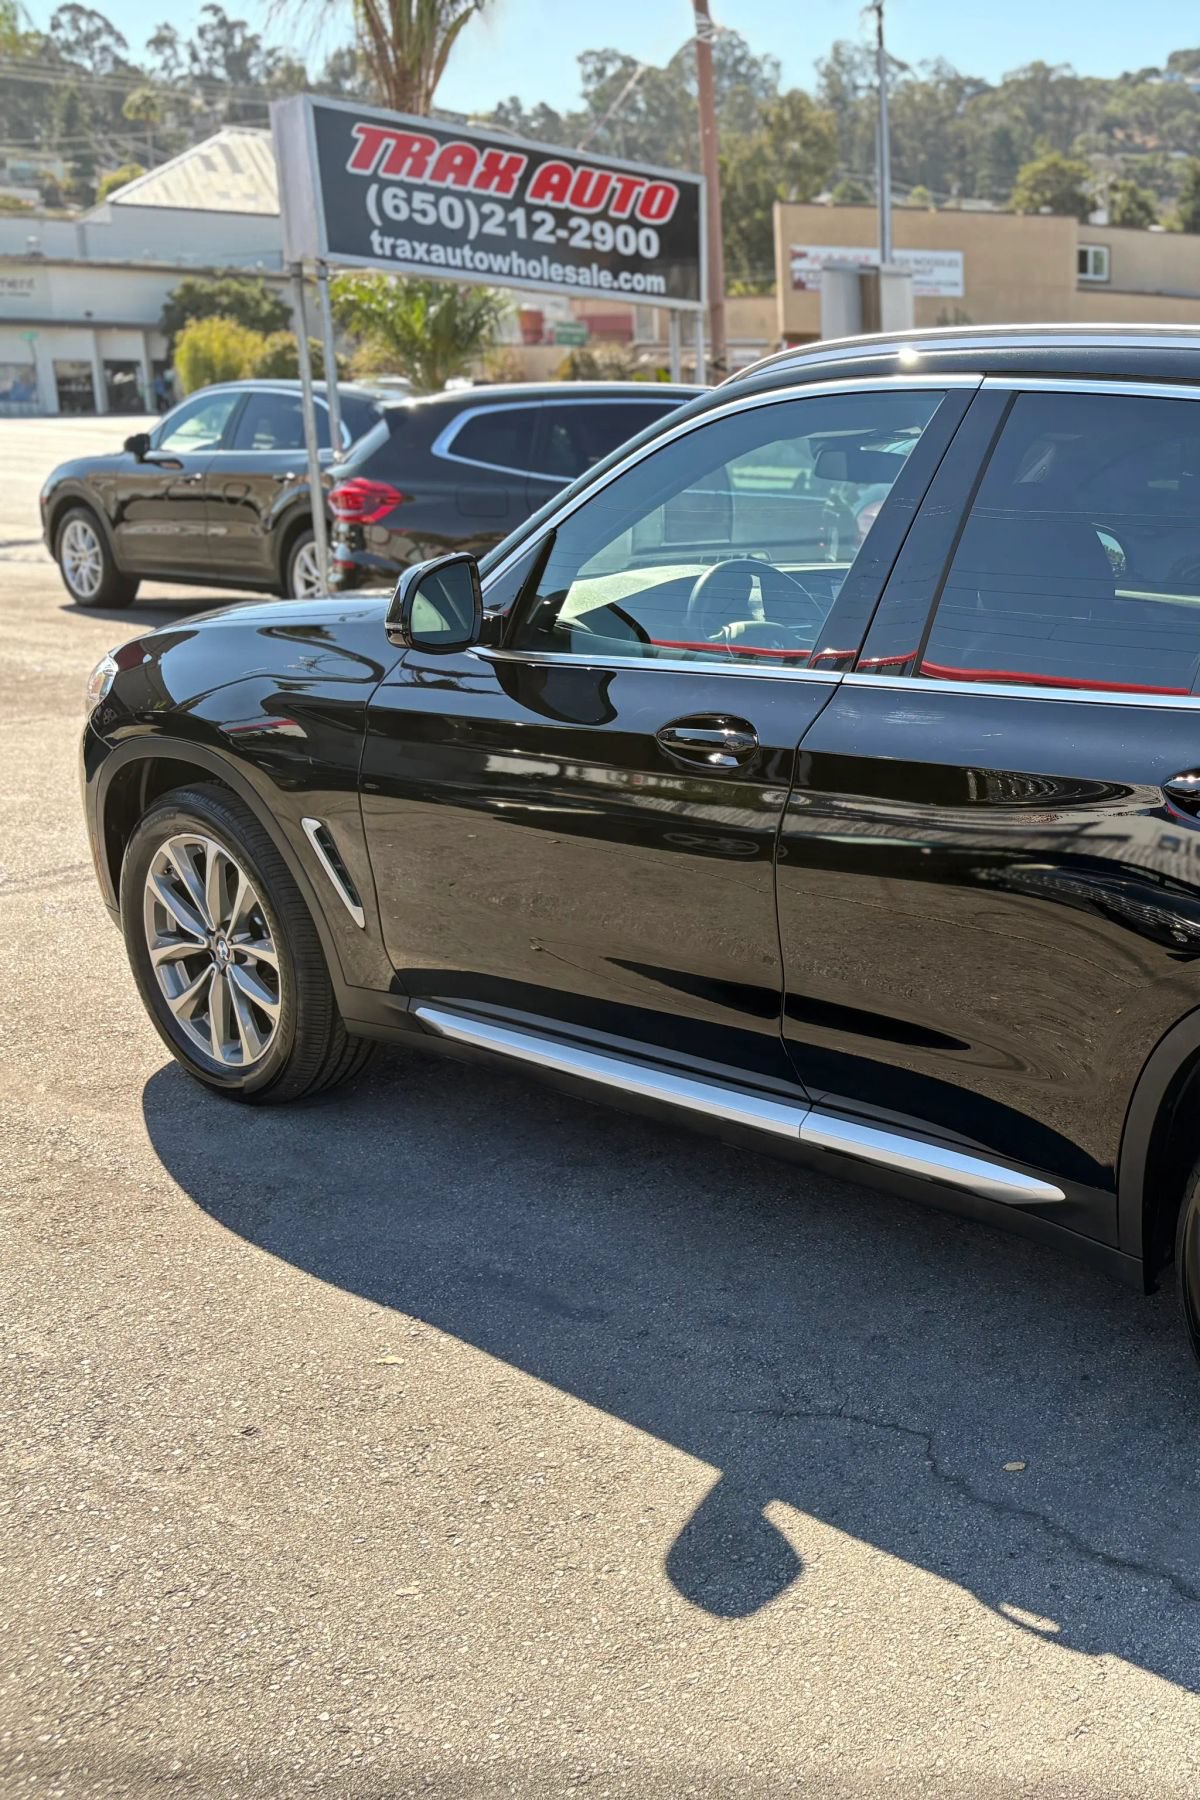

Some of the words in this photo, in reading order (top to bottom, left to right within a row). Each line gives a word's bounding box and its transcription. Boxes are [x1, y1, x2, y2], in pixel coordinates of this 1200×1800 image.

[346, 122, 527, 199] TRAX
[525, 160, 680, 225] AUTO
[366, 183, 660, 259] (650)212-2900
[370, 229, 667, 293] traxautowholesale.com
